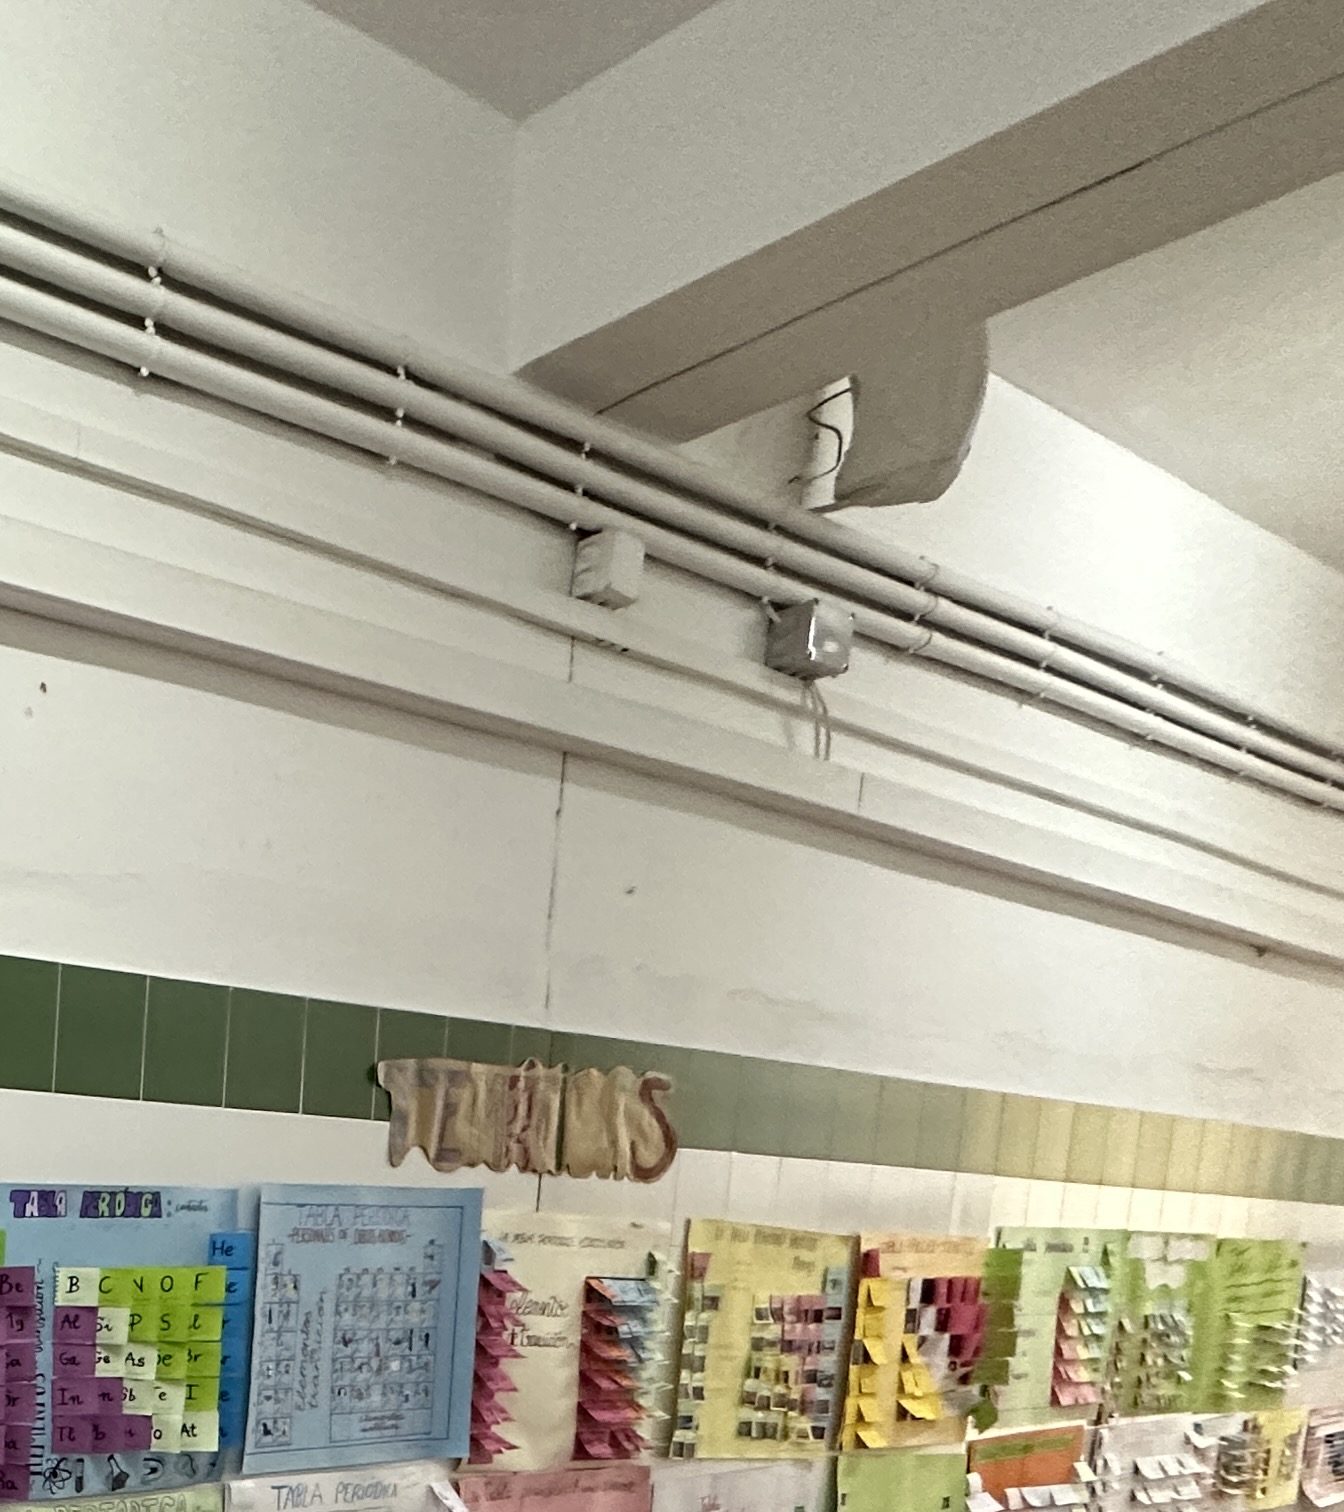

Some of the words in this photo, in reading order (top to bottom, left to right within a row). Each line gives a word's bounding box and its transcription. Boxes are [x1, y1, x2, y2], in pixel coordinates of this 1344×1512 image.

[212, 1240, 235, 1257] He
[65, 1275, 81, 1294] B
[98, 1275, 113, 1294] C
[160, 1275, 174, 1293] O
[194, 1272, 210, 1291] F
[60, 1313, 82, 1330] Al
[129, 1314, 143, 1332] P
[160, 1314, 171, 1331] S
[125, 1351, 145, 1367] As
[57, 1388, 84, 1406] In
[186, 1384, 200, 1400] I
[181, 1423, 198, 1438] At
[271, 1482, 323, 1511] TABLA
